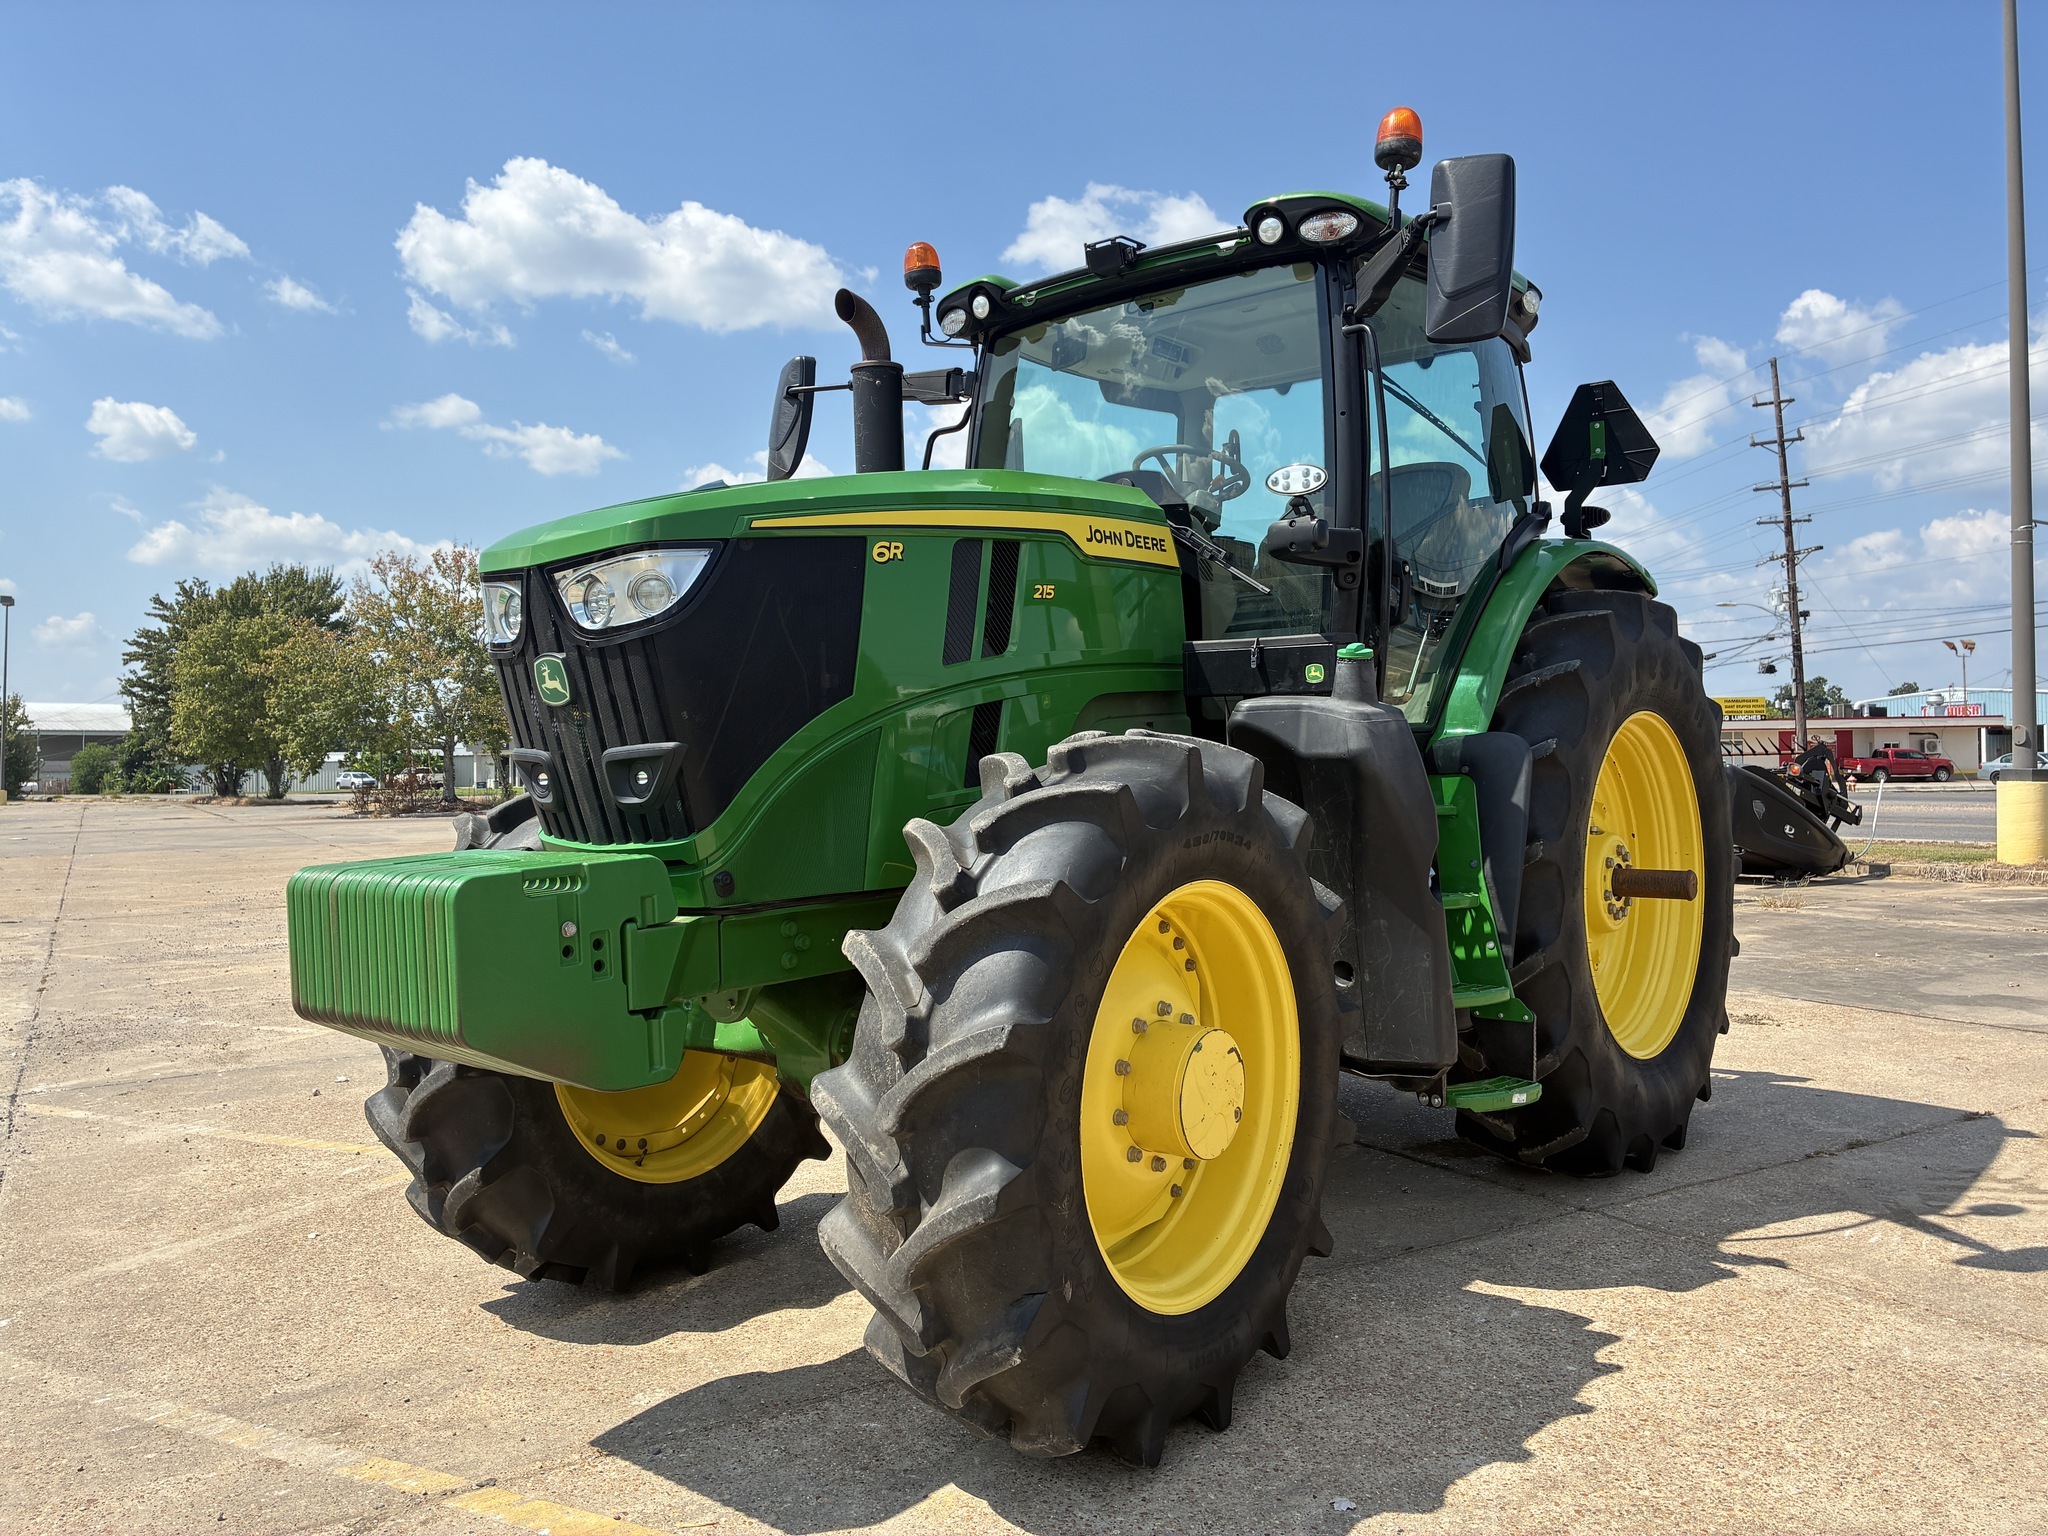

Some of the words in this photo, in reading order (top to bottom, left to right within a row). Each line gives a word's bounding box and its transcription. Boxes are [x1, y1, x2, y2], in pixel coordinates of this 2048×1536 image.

[1086, 525, 1123, 546] JOHN
[1124, 529, 1167, 552] DEERE
[872, 541, 903, 563] 6R
[1033, 584, 1055, 599] 215
